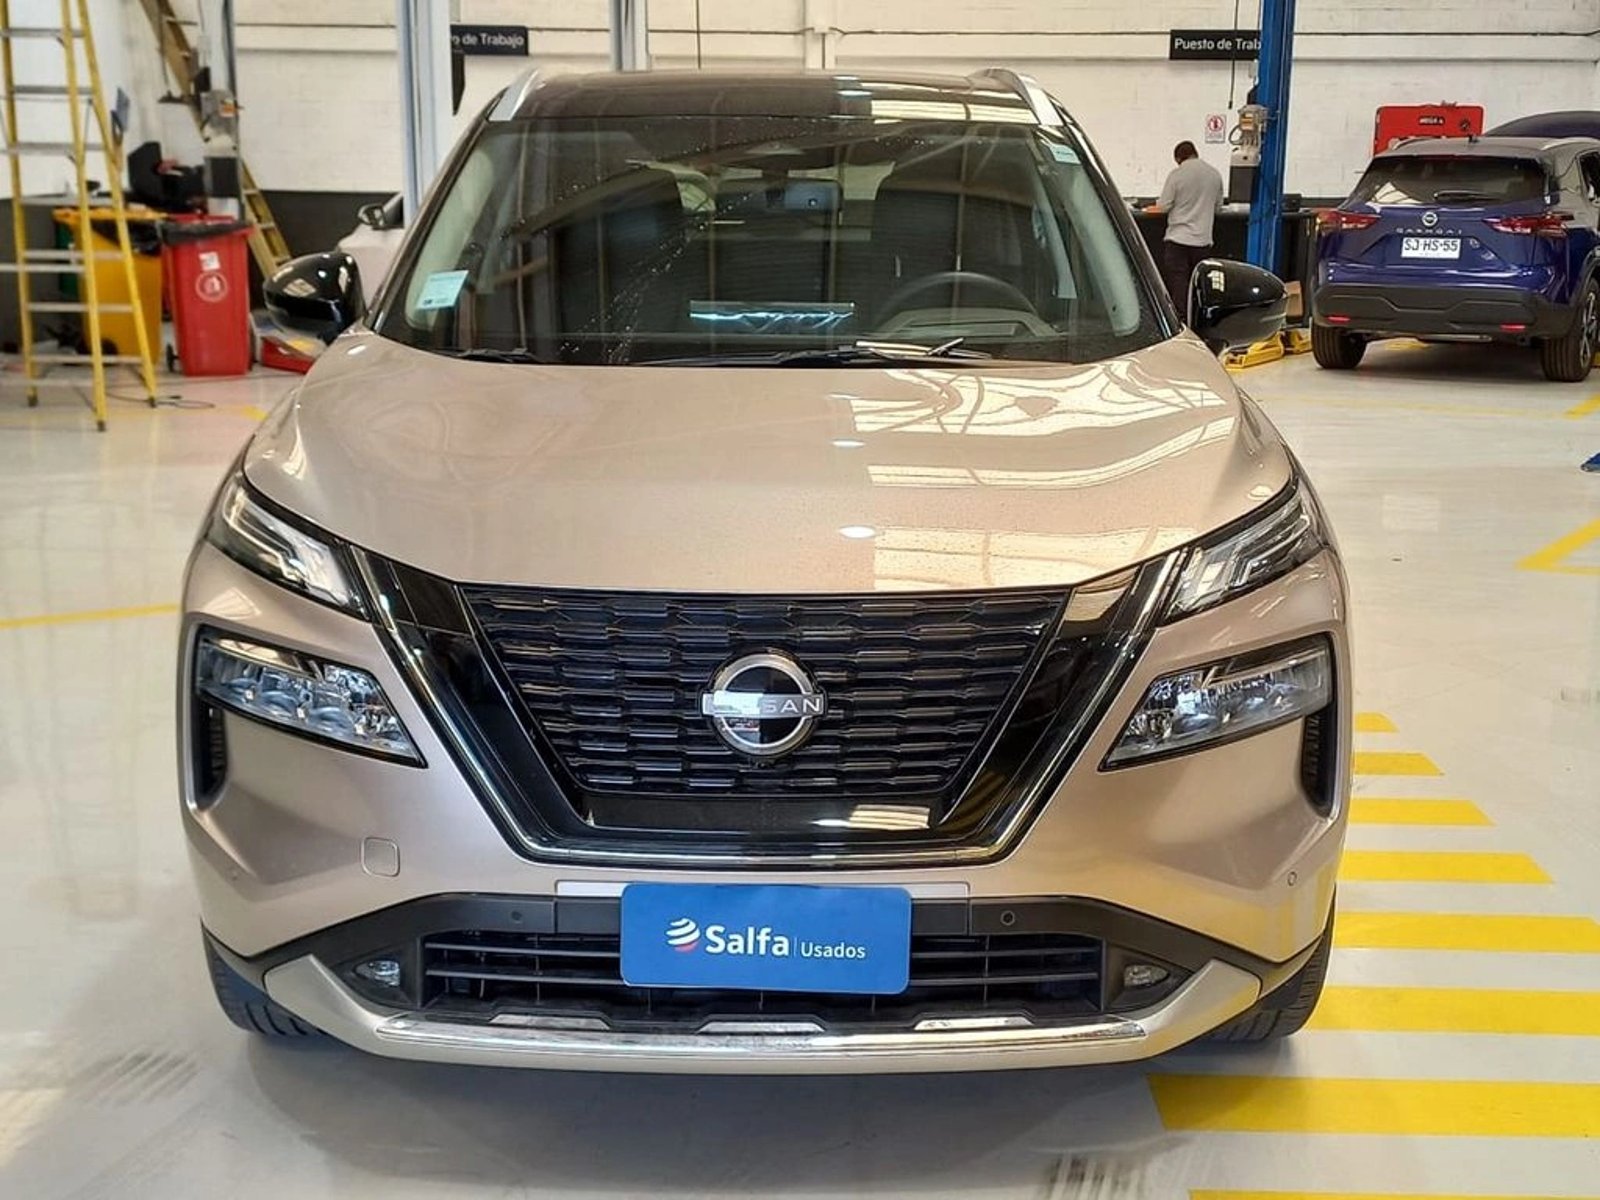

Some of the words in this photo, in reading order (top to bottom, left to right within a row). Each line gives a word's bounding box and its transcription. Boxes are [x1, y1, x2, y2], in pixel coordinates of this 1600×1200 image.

[462, 33, 478, 45] de
[480, 33, 525, 48] Trabajo
[1174, 37, 1215, 50] Puesto
[1216, 37, 1232, 50] de
[1235, 38, 1261, 50] Trab
[705, 925, 790, 957] Salfa
[801, 942, 867, 959] Usados
